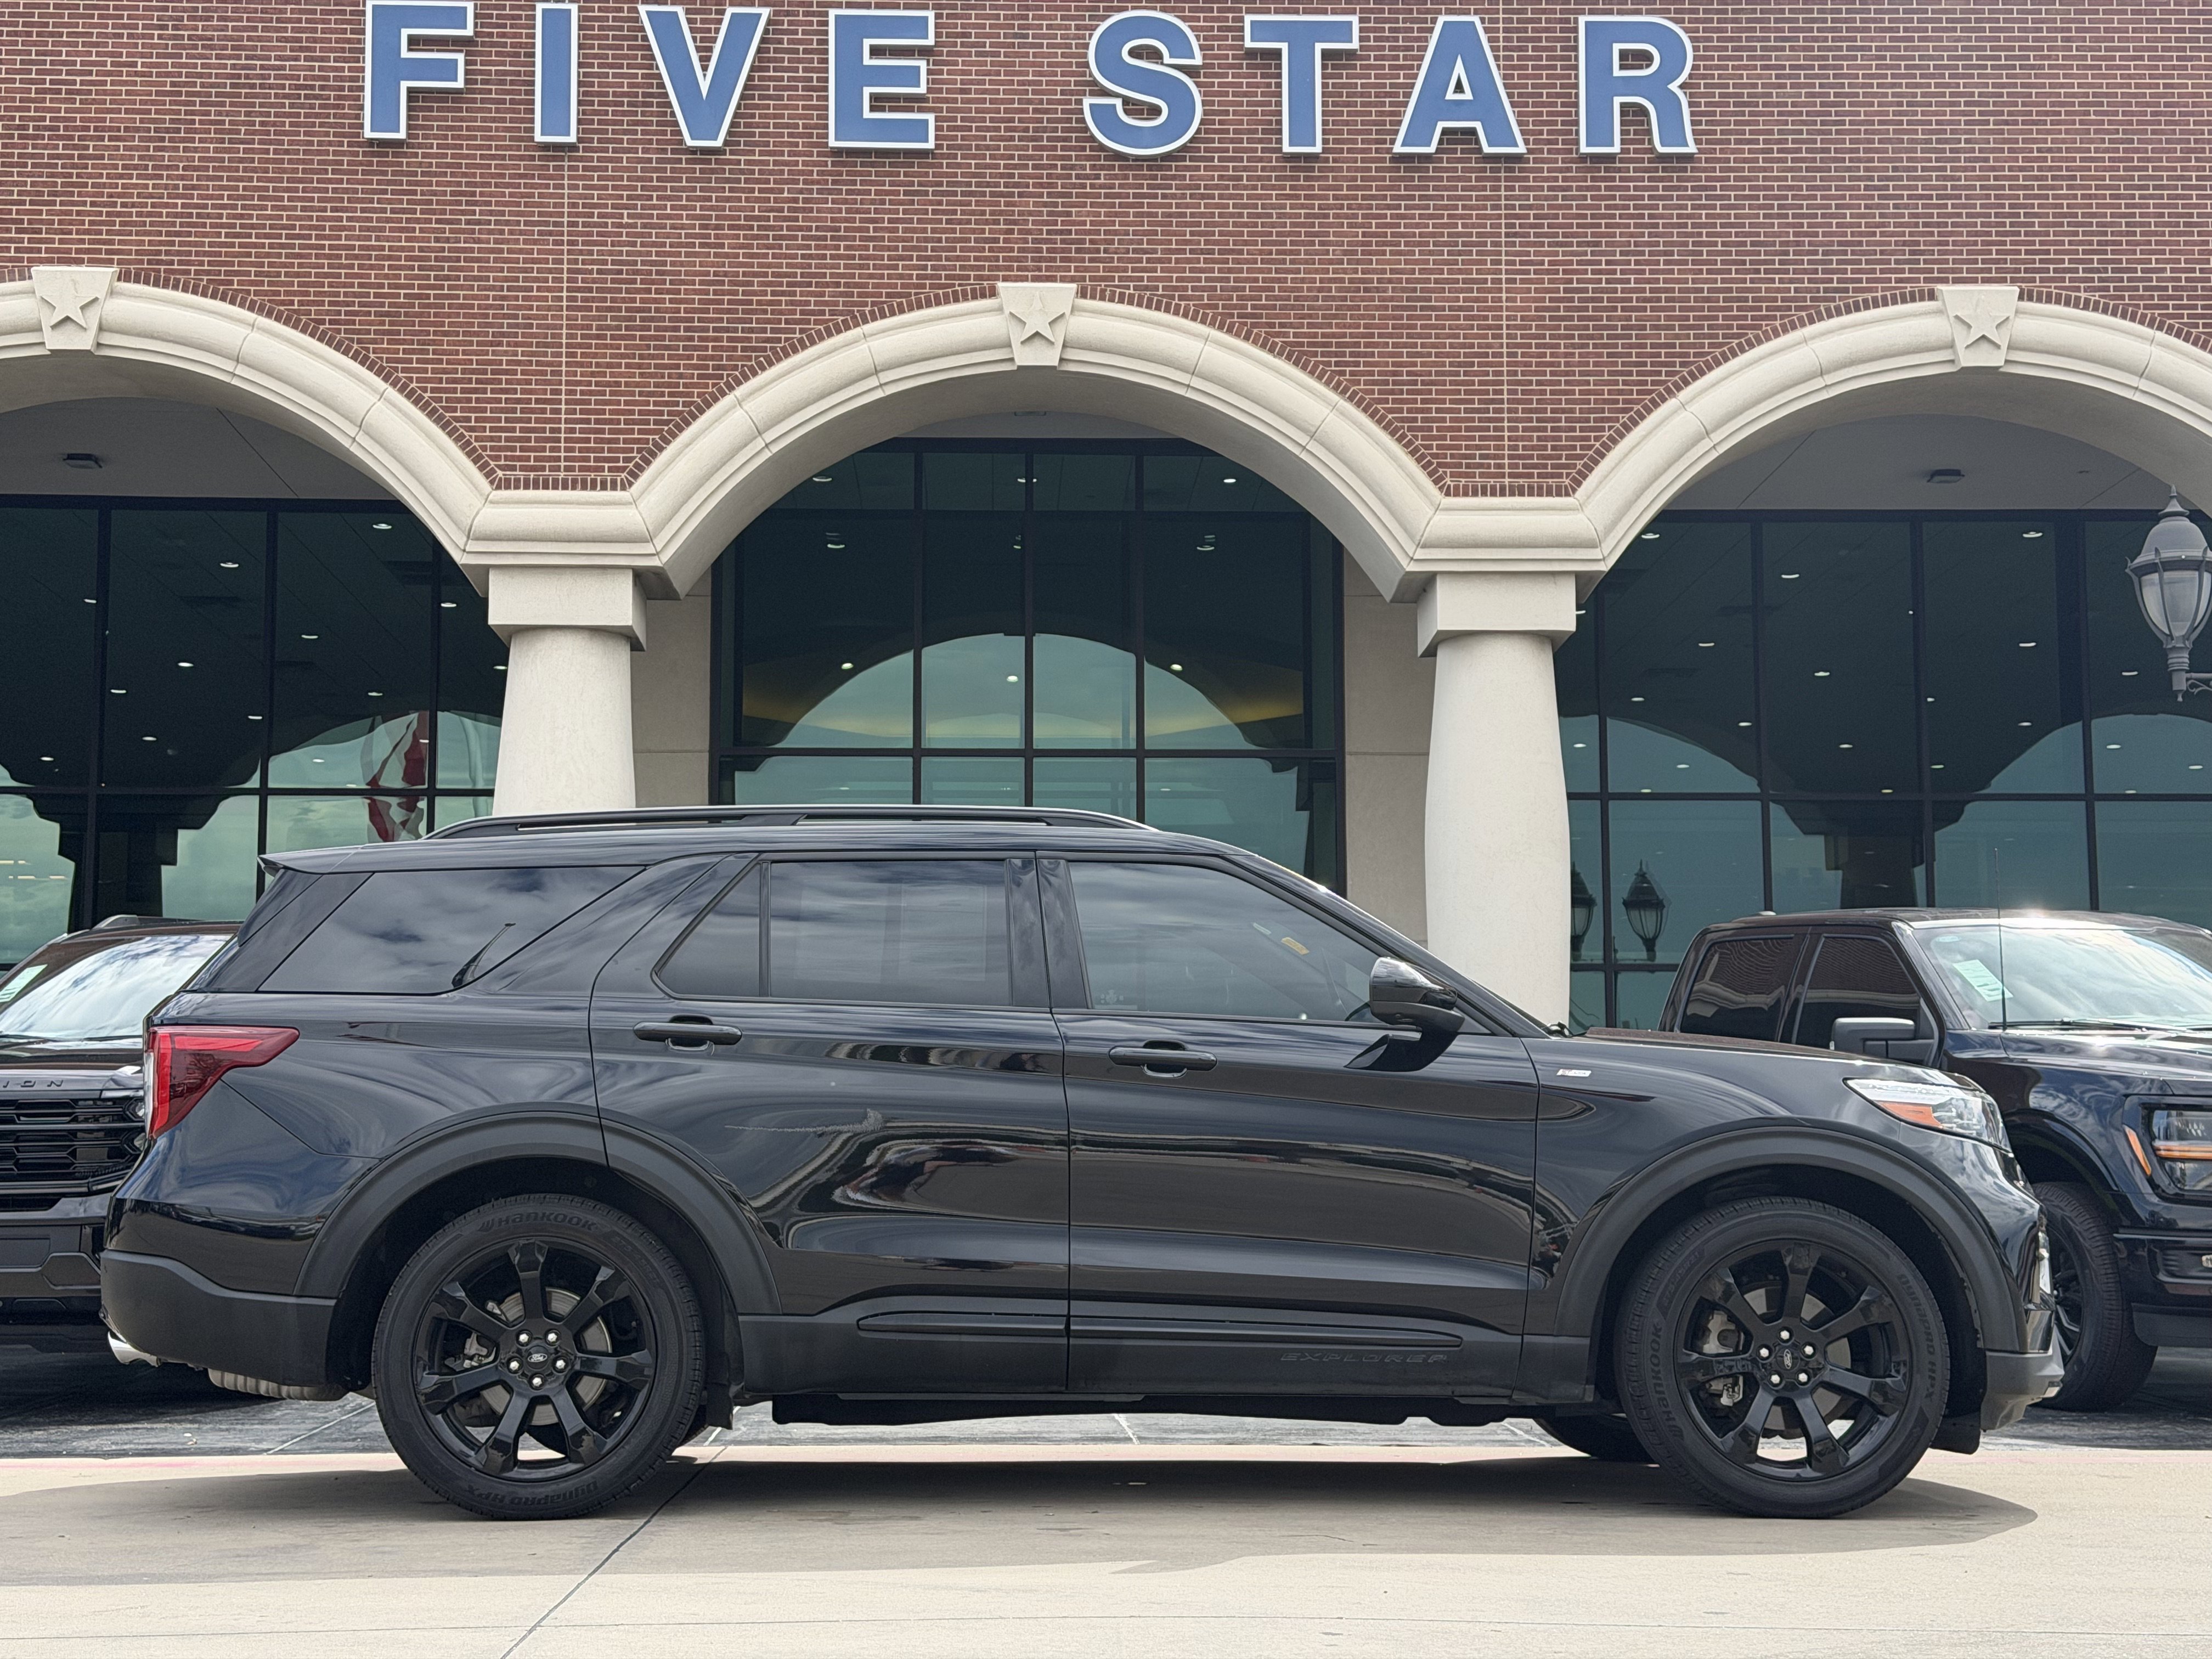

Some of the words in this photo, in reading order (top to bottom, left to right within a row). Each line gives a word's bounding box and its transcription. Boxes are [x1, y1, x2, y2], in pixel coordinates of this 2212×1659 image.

[363, 0, 935, 151] FIVE
[1083, 9, 1699, 159] STAR
[1280, 1352, 1447, 1363] EXPLORER
